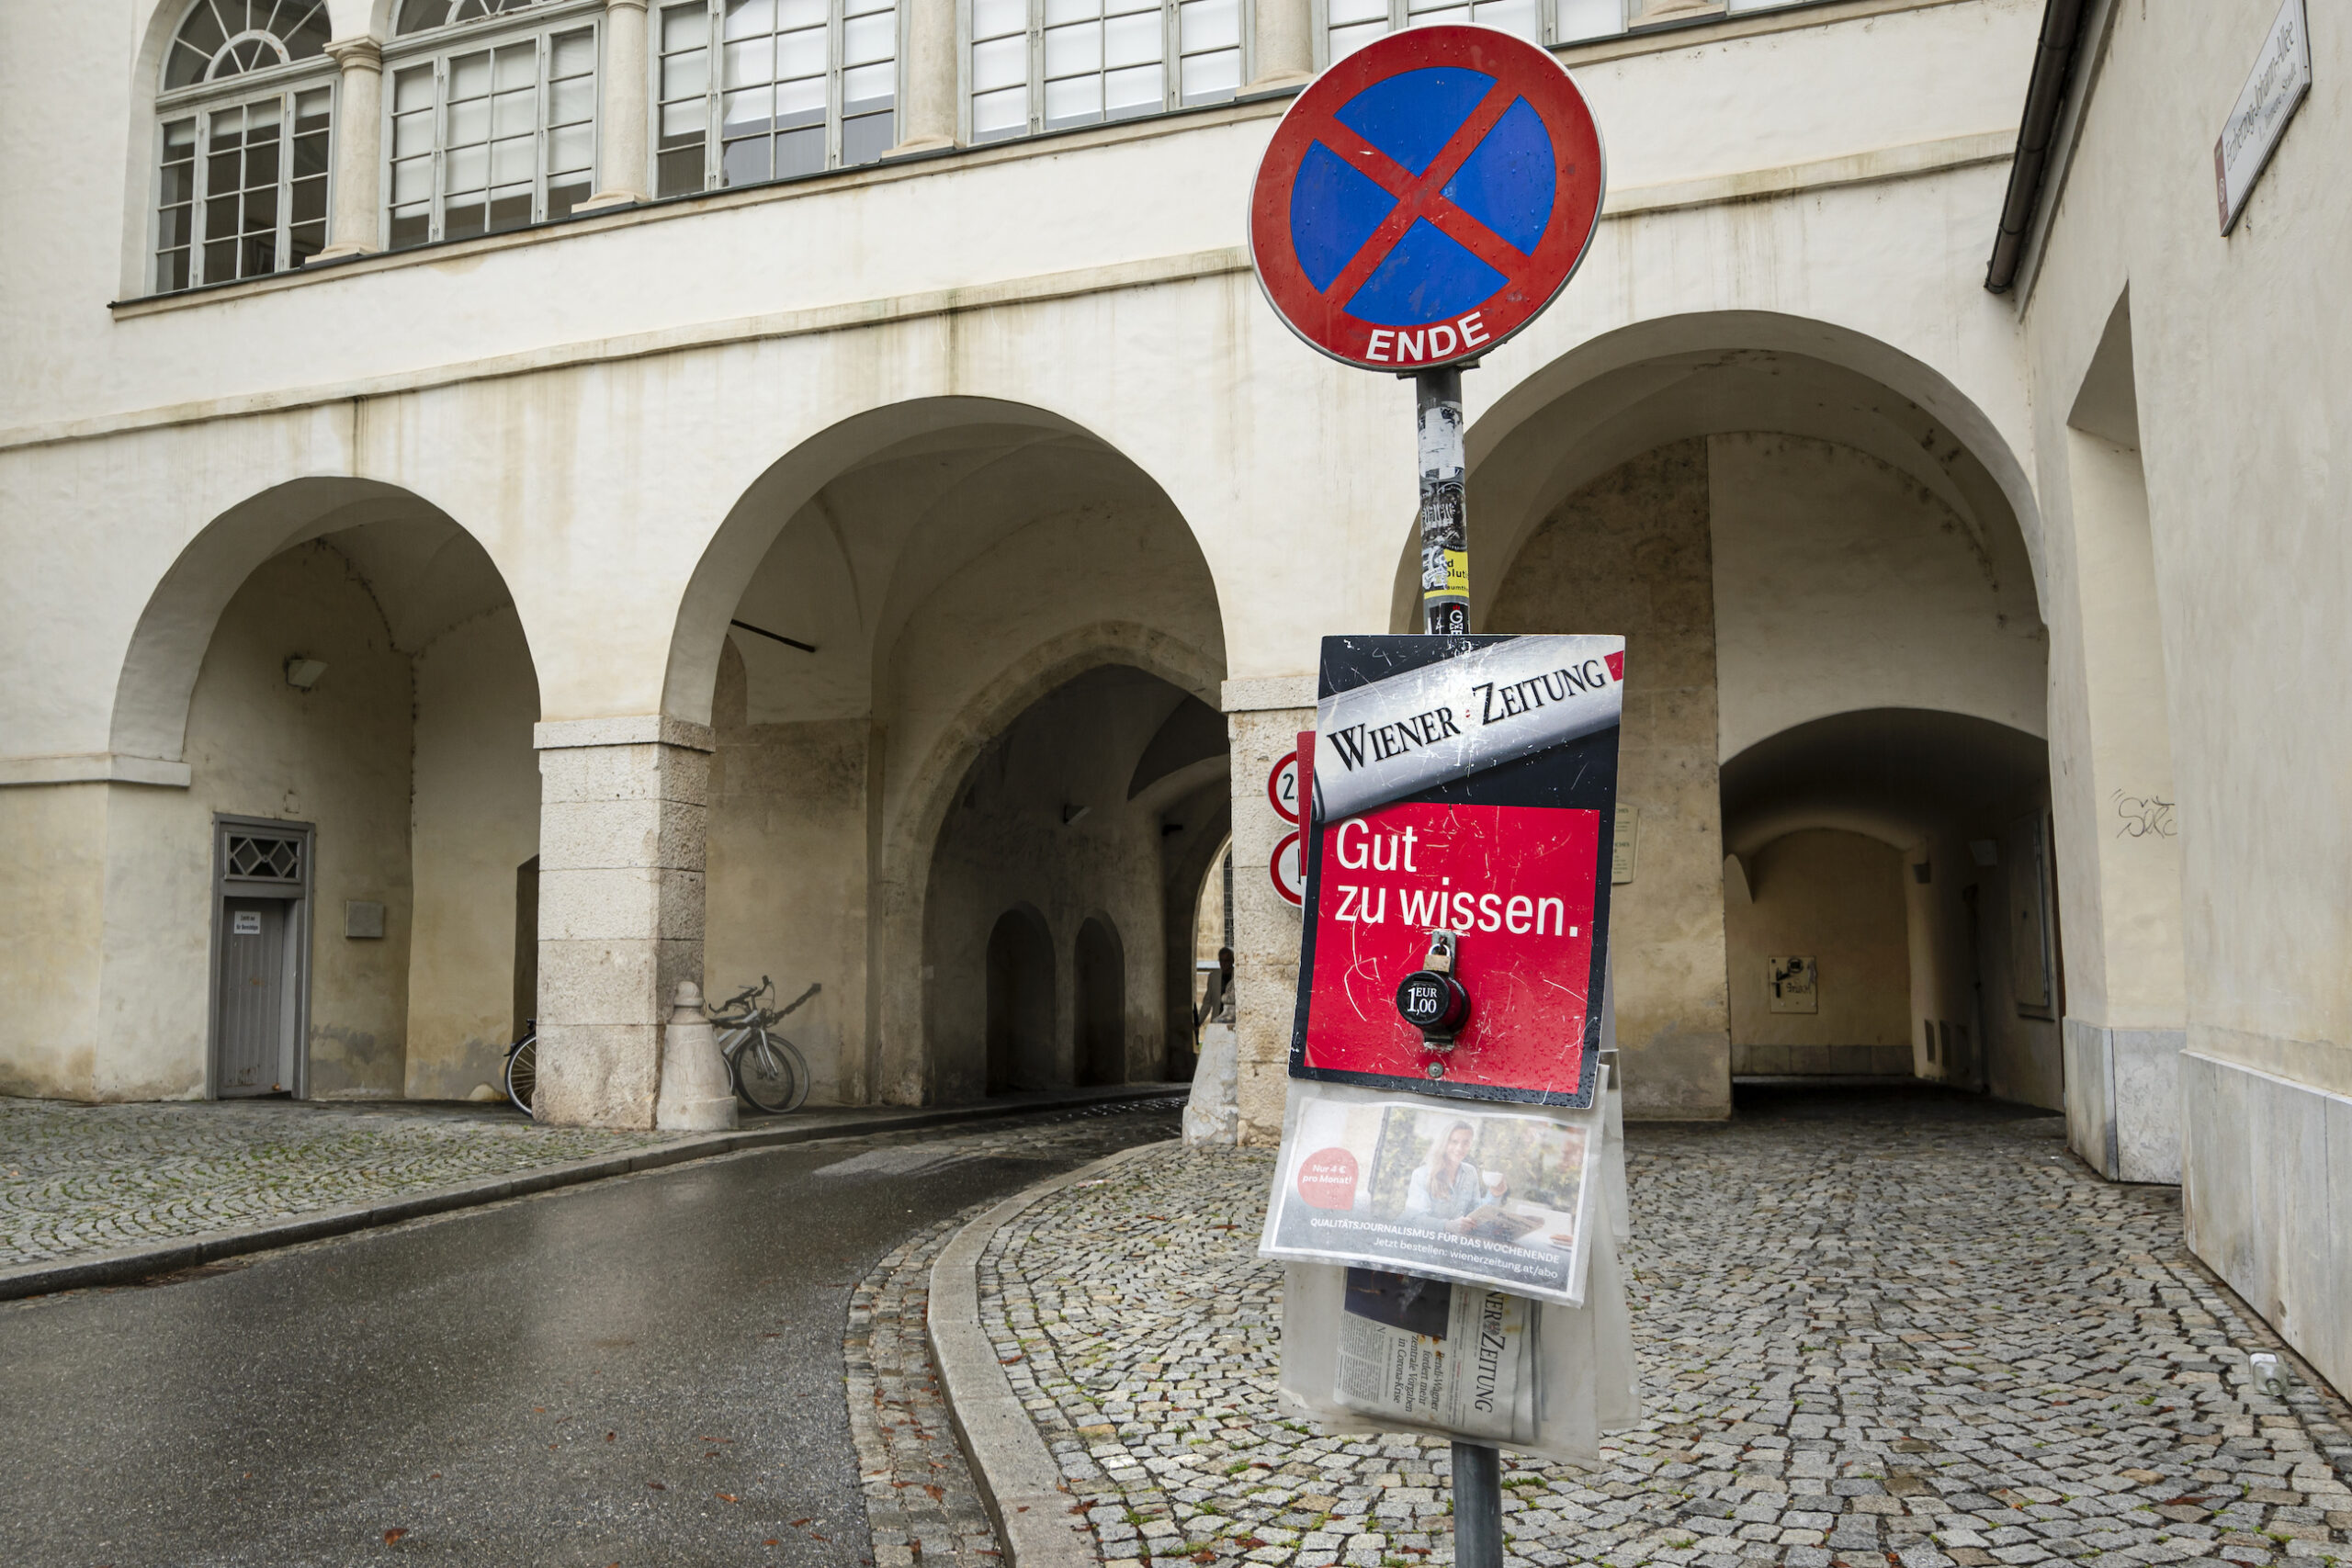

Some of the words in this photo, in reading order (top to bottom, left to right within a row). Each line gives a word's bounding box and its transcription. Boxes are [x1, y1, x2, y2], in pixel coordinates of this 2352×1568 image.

[1366, 311, 1490, 362] ENDE
[1327, 706, 1461, 772] WIENER
[1472, 660, 1606, 726] ZEITUNG
[1337, 818, 1418, 873] Gut
[1335, 885, 1386, 924] zu
[1399, 876, 1578, 937] wissen.
[1416, 987, 1438, 998] EUR
[1312, 1164, 1329, 1172] Nur
[1330, 1165, 1337, 1173] 4
[1339, 1166, 1347, 1174] €
[1319, 1175, 1352, 1184] Monat!
[1310, 1218, 1435, 1240] QUALITÄTSJOURNALISMUS
[1437, 1232, 1458, 1244] FÜR
[1460, 1236, 1481, 1248] DAS
[1483, 1241, 1560, 1264] WOCHENENDE
[1374, 1237, 1397, 1248] Jetzt
[1399, 1240, 1448, 1256] bestellen:
[1450, 1250, 1558, 1279] wienerzeitung.at/abo
[1398, 1337, 1408, 1347] in
[1408, 1336, 1421, 1371] zentrale
[1393, 1348, 1408, 1404] Corona-Krise
[1420, 1349, 1433, 1381] fordert
[1474, 1332, 1506, 1414] ZEITUNG
[1404, 1373, 1419, 1413] Vorgaben
[1418, 1382, 1430, 1406] mehr
